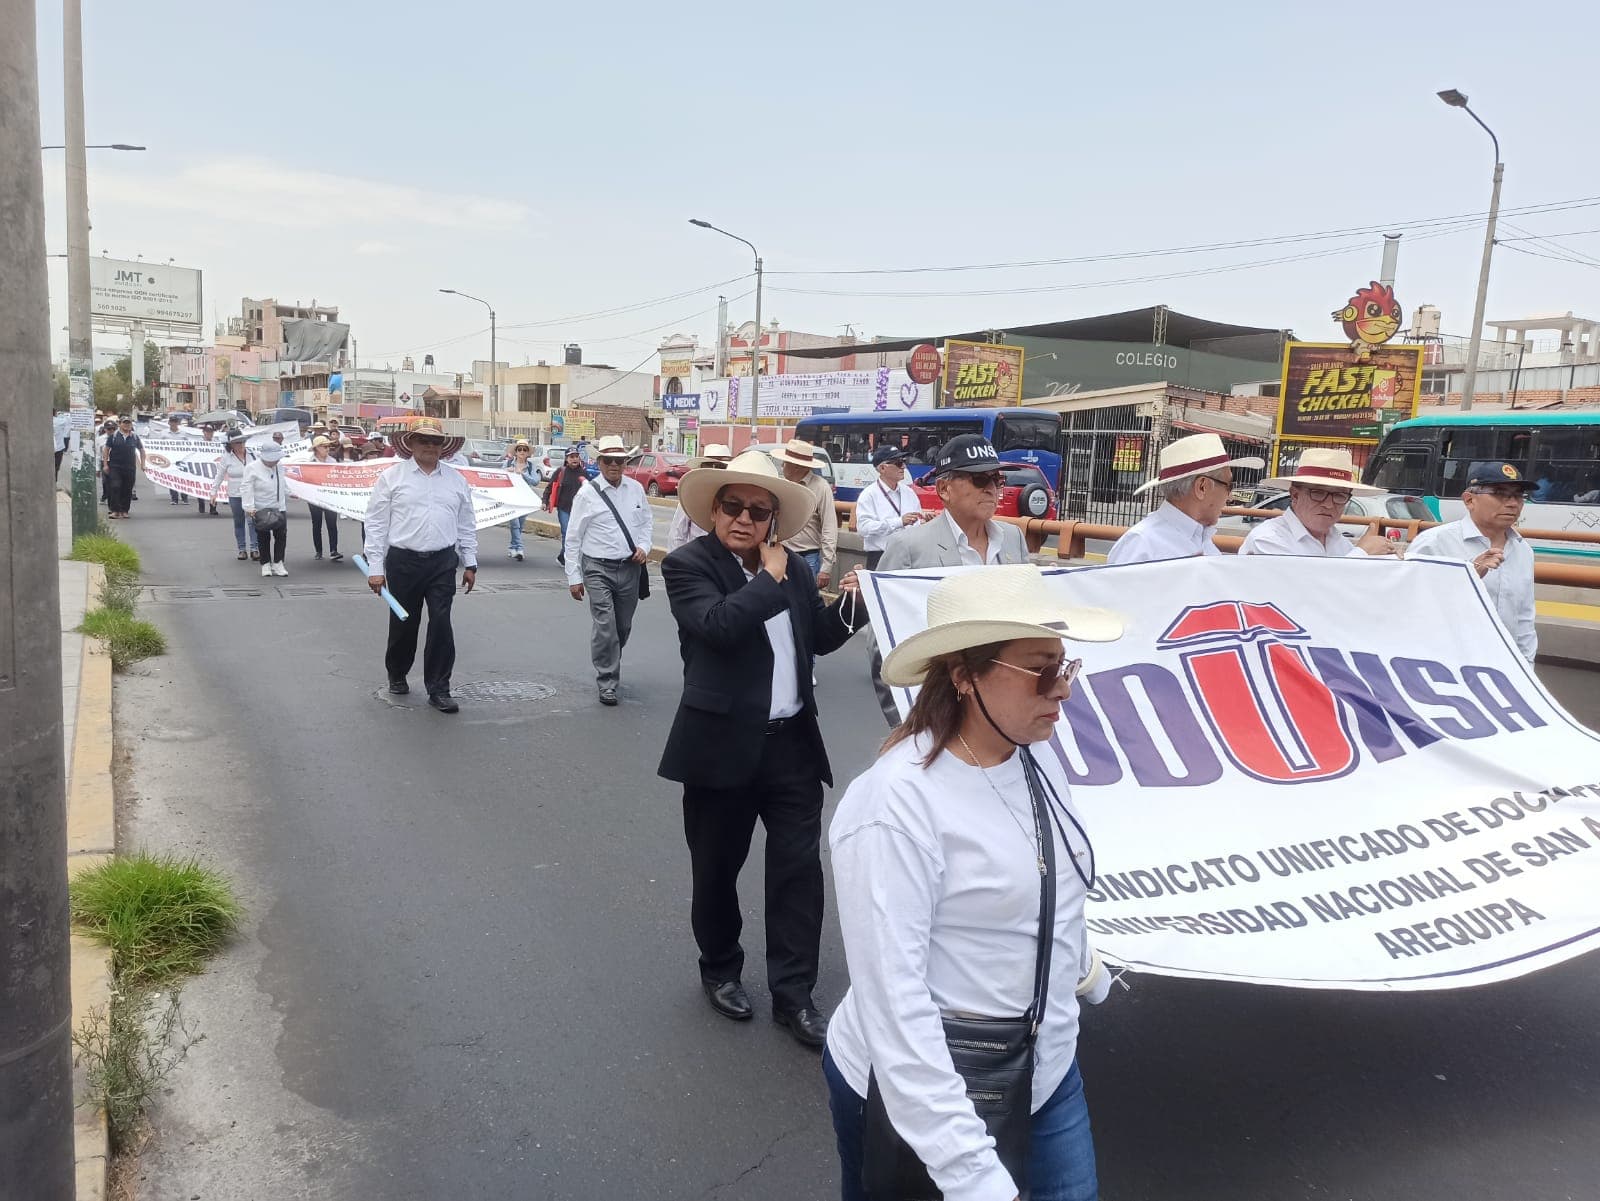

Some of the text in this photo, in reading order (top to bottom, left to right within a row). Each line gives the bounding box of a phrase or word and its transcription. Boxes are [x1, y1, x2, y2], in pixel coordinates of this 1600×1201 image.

[114, 270, 142, 282] JMT
[1116, 352, 1177, 369] COLEGIO
[956, 362, 998, 385] FAST
[1301, 366, 1377, 395] FAST
[953, 384, 997, 400] CHICKEN
[1297, 394, 1372, 412] CHICKEN
[966, 445, 999, 459] UNS
[175, 460, 218, 480] SUD
[1087, 854, 1261, 902] SINDICATO
[1257, 824, 1430, 877] UNIFICADO
[1422, 811, 1480, 842] DE
[1086, 901, 1308, 935] UNIVERSIDAD
[1302, 867, 1477, 923] NACIONAL
[1462, 851, 1524, 884] DE
[1511, 827, 1592, 867] SAN
[1374, 898, 1546, 960] AREQUIPA
